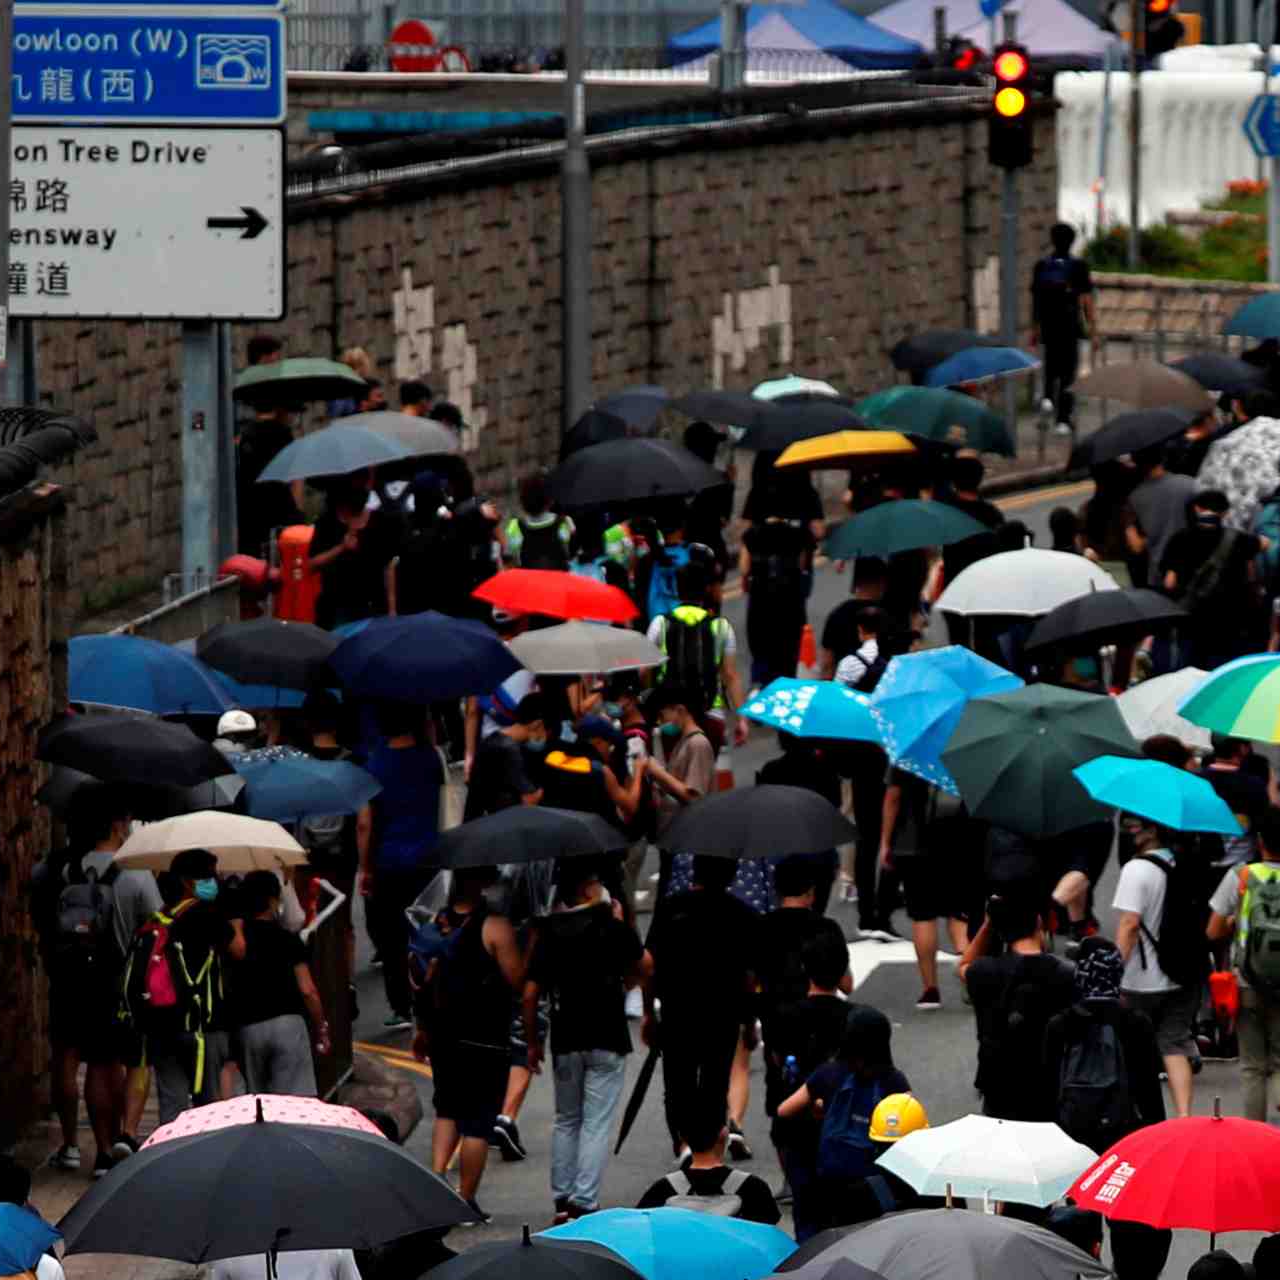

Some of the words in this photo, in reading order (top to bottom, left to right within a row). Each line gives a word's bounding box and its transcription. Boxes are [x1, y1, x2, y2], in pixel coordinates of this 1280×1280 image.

[15, 27, 119, 51] owloon
[131, 27, 188, 58] (W)
[58, 139, 120, 162] Tree
[131, 140, 208, 163] Drive
